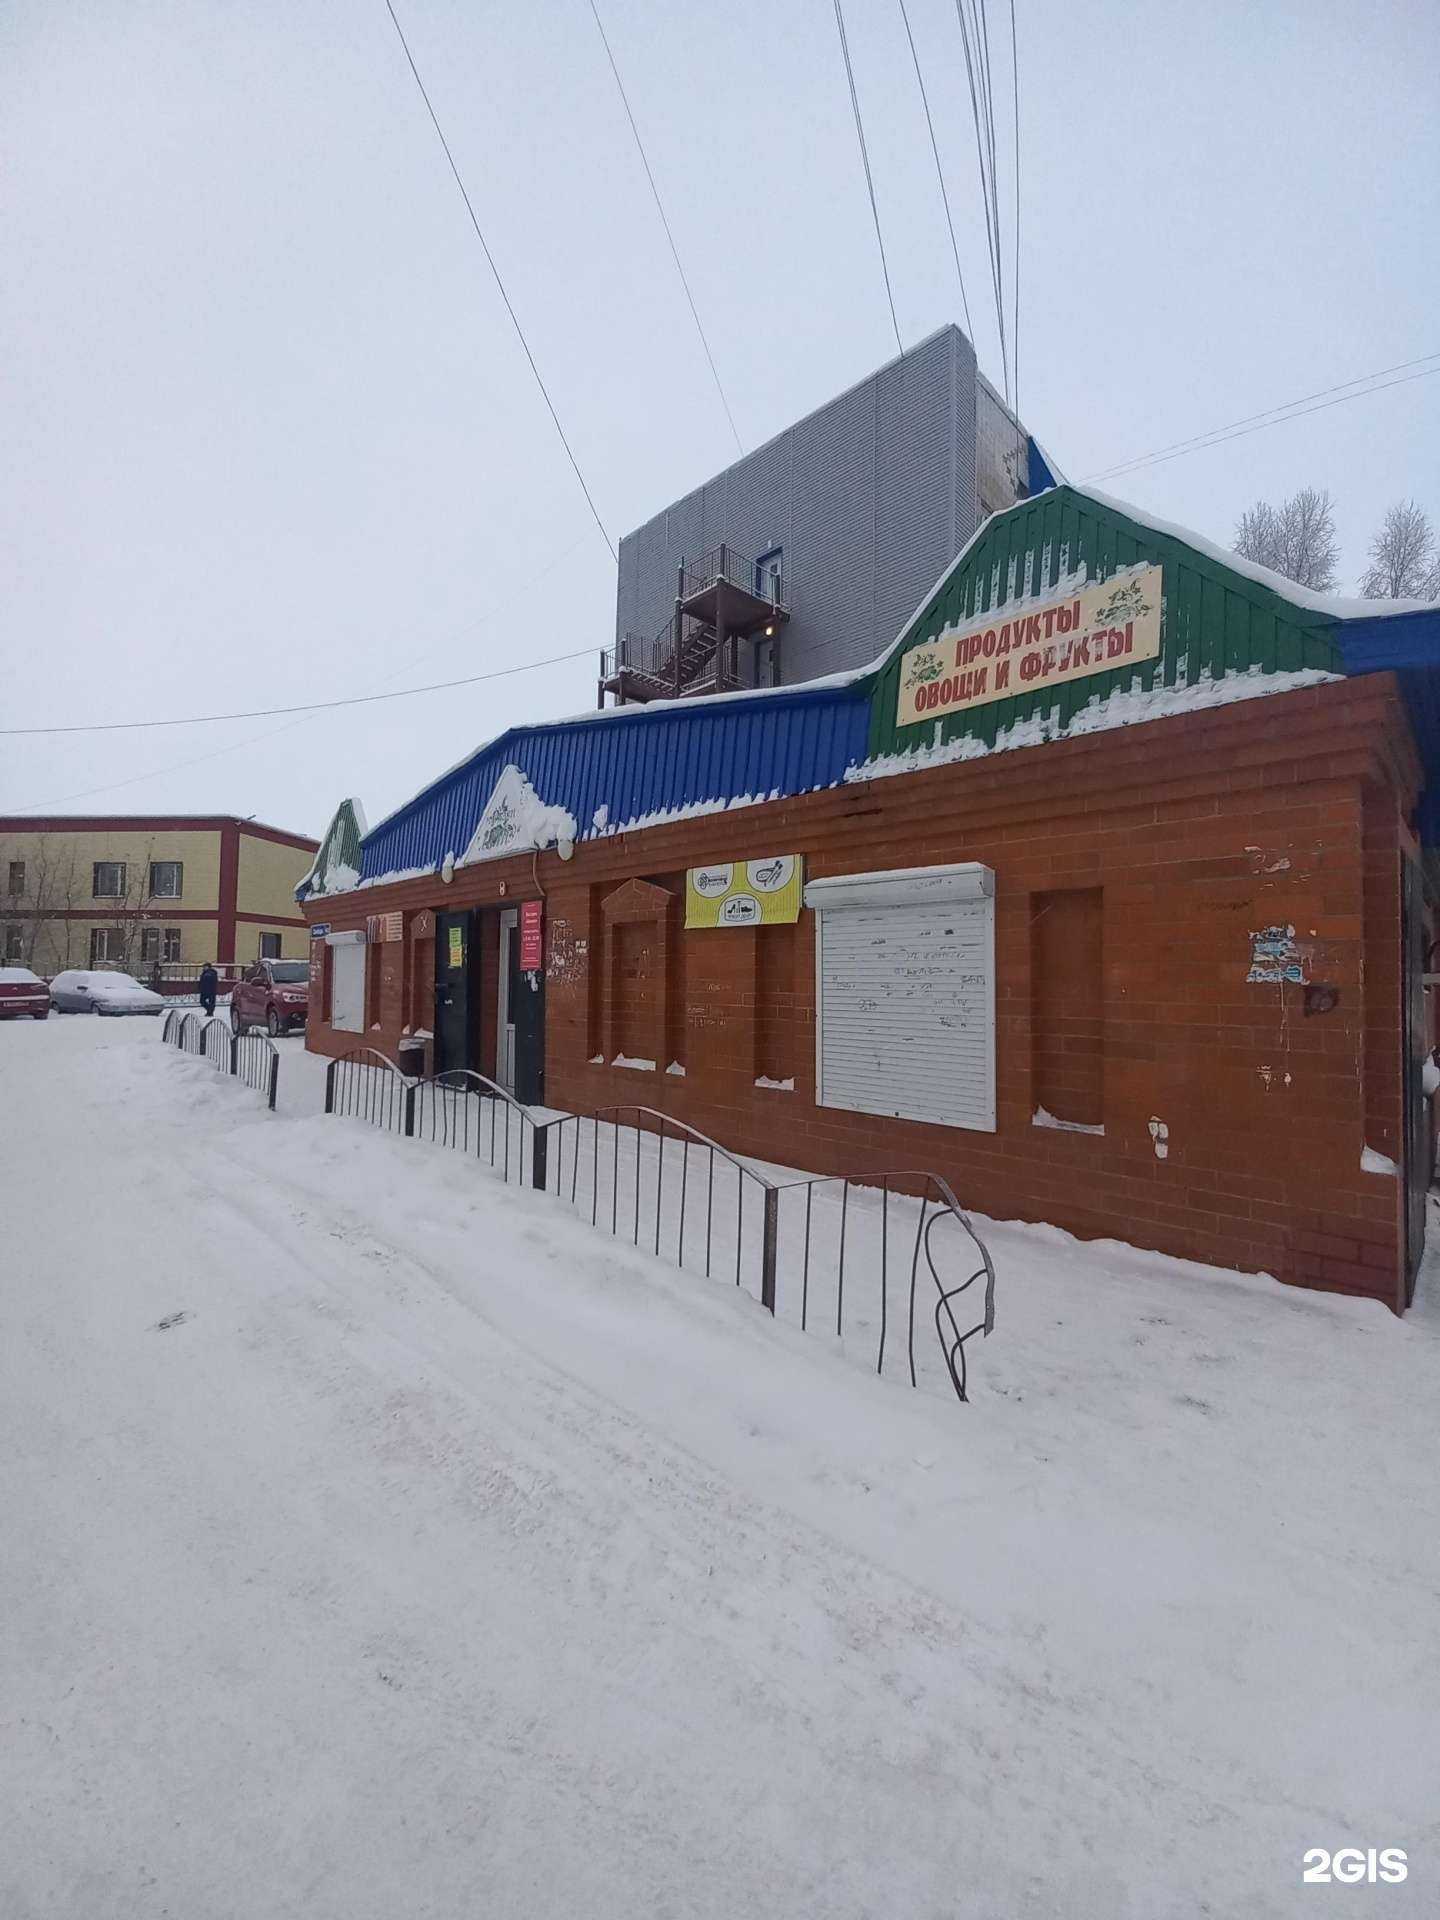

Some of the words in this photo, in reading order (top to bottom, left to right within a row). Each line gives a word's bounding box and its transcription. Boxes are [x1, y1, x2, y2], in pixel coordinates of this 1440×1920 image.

[955, 600, 1081, 668] ПРОДУКТЫ
[914, 667, 987, 712] ОВОЩИ
[995, 659, 1010, 690] И
